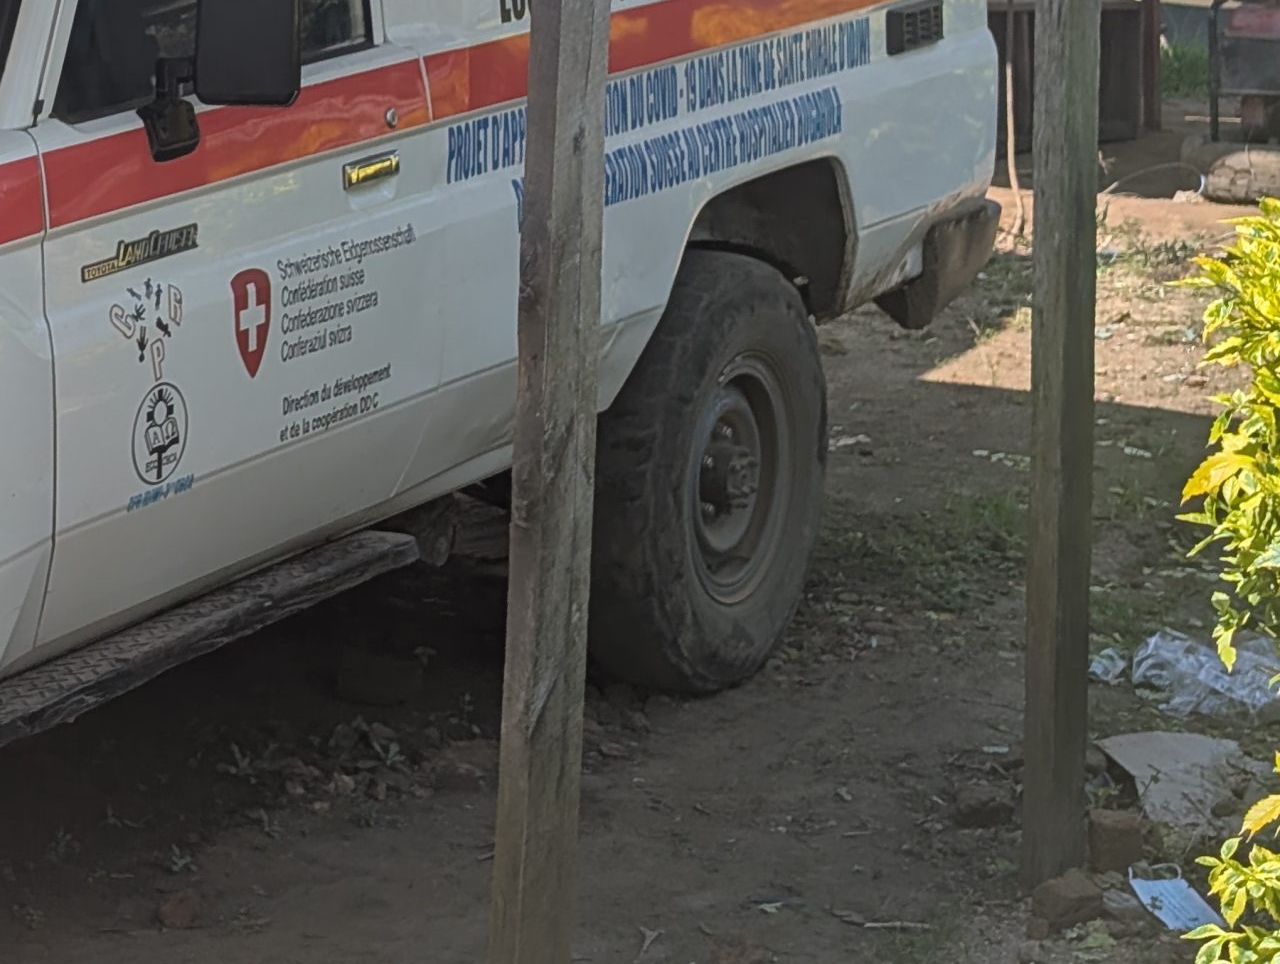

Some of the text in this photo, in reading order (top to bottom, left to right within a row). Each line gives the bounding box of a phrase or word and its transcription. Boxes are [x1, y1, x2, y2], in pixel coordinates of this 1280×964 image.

[447, 116, 489, 185] PROJET
[492, 105, 528, 171] D'APP
[630, 74, 645, 130] DU
[646, 65, 678, 125] COVID
[684, 60, 697, 113] 19
[698, 52, 726, 109] DANS
[726, 47, 740, 102] LA
[739, 43, 763, 98] ZONE
[763, 39, 777, 92] DE
[644, 131, 687, 192] SUISSE
[682, 126, 700, 181] AU
[696, 116, 738, 177] CENTRE
[734, 99, 796, 165] HOSPITALIER
[85, 261, 117, 280] TOYOTA
[277, 244, 343, 281] Schweizerische
[281, 267, 365, 308] Confédération suisse
[281, 291, 379, 335] Confederazione svizzera
[282, 362, 392, 416] Direction du développement
[280, 425, 289, 442] et
[290, 421, 300, 439] de
[302, 417, 310, 435] la
[311, 402, 359, 432] coopération
